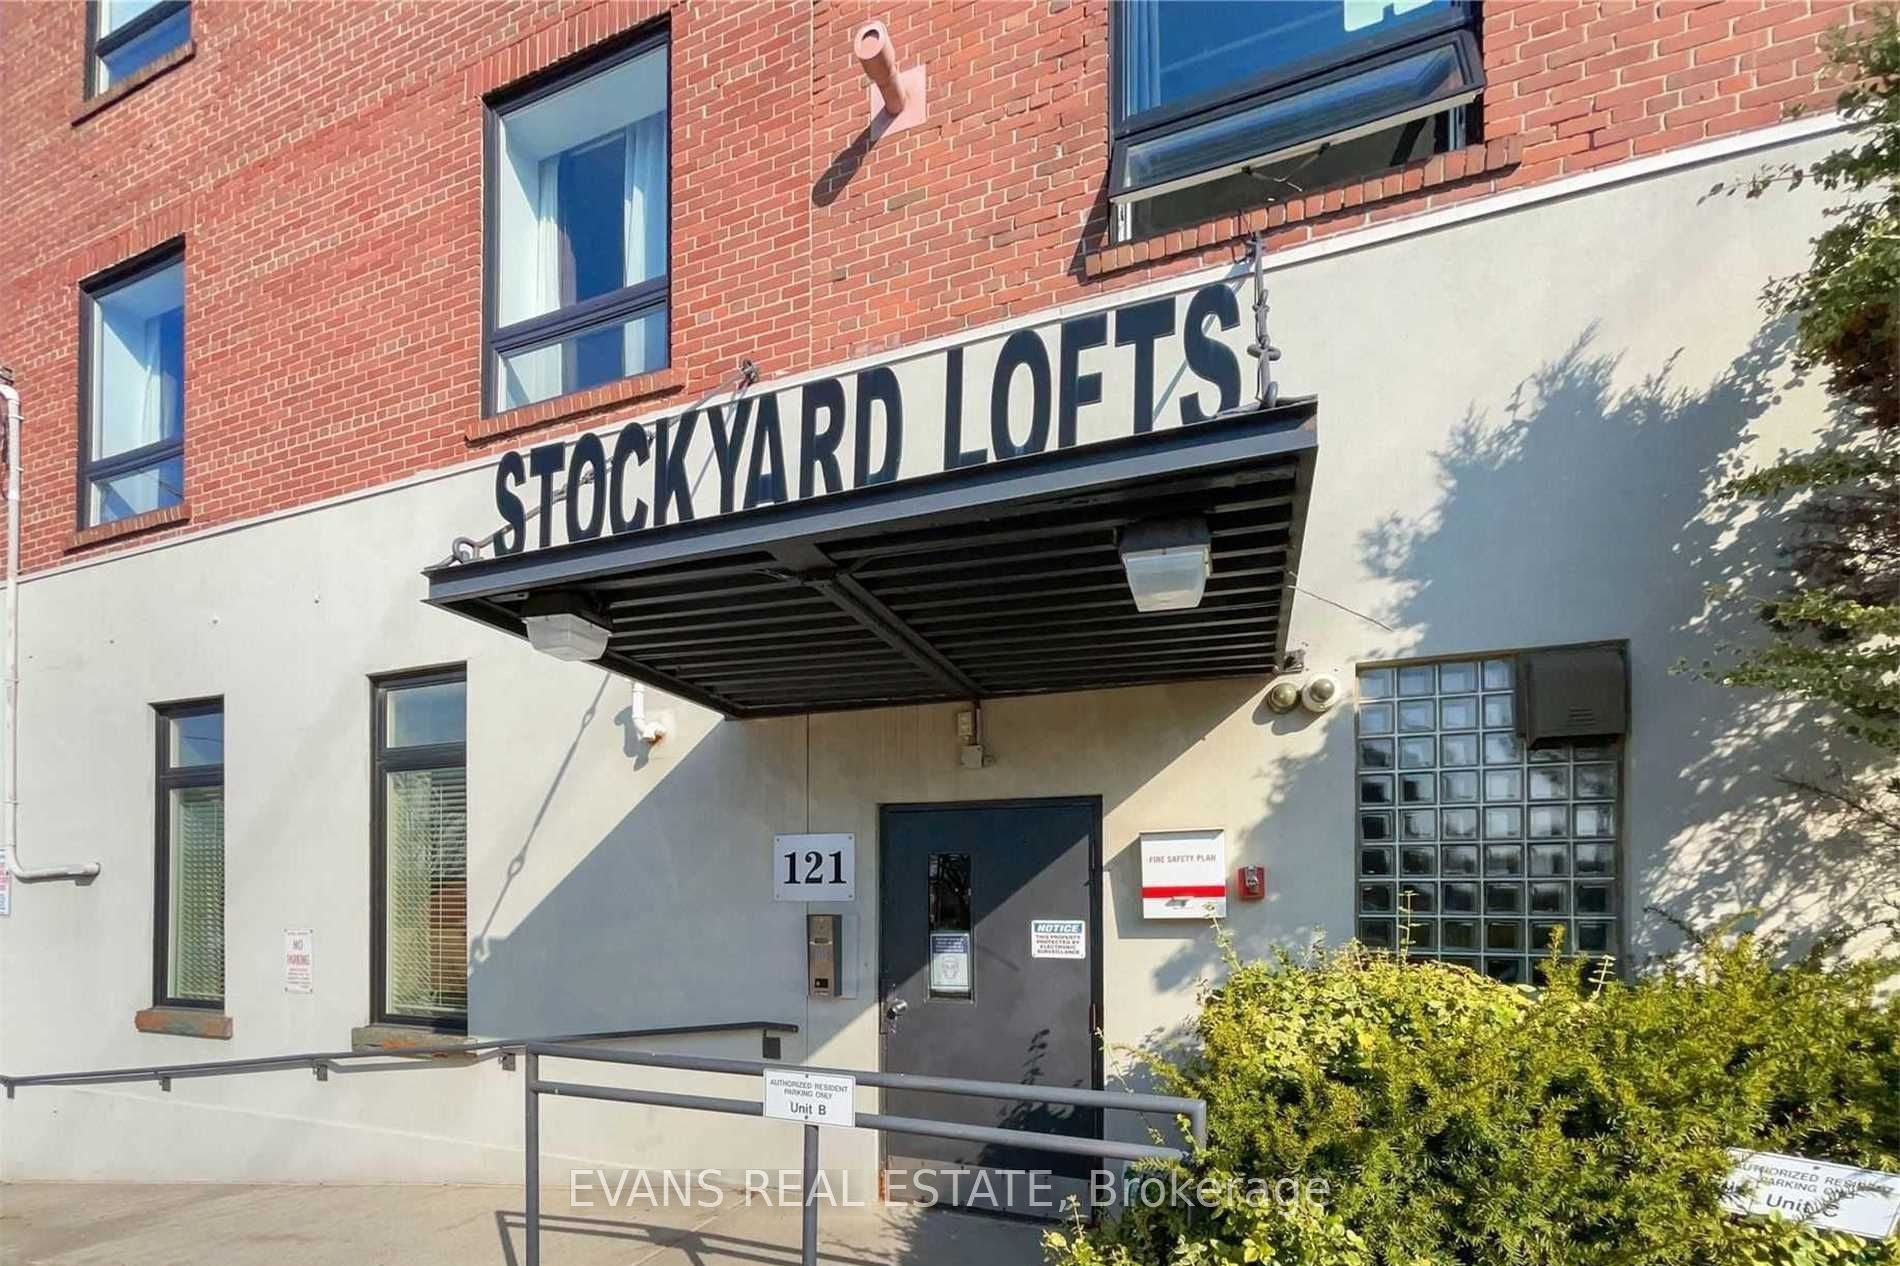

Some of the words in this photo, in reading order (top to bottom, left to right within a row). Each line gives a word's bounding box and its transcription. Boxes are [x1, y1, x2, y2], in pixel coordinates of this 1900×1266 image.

[493, 366, 904, 560] STOCKYARD
[943, 283, 1242, 471] LOFTS
[1149, 855, 1165, 864] FIRE
[1167, 854, 1195, 863] SAFETY
[1196, 853, 1217, 863] PLAN
[784, 850, 847, 884] 121
[1036, 923, 1081, 933] NOTICE
[770, 1079, 812, 1089] AUTHORIZED
[814, 1083, 848, 1093] RESIDENT
[784, 1088, 813, 1097] PARKING
[815, 1091, 832, 1100] ONLY
[790, 1101, 812, 1115] Unit
[818, 1104, 826, 1116] B
[1766, 1193, 1811, 1213] Unit
